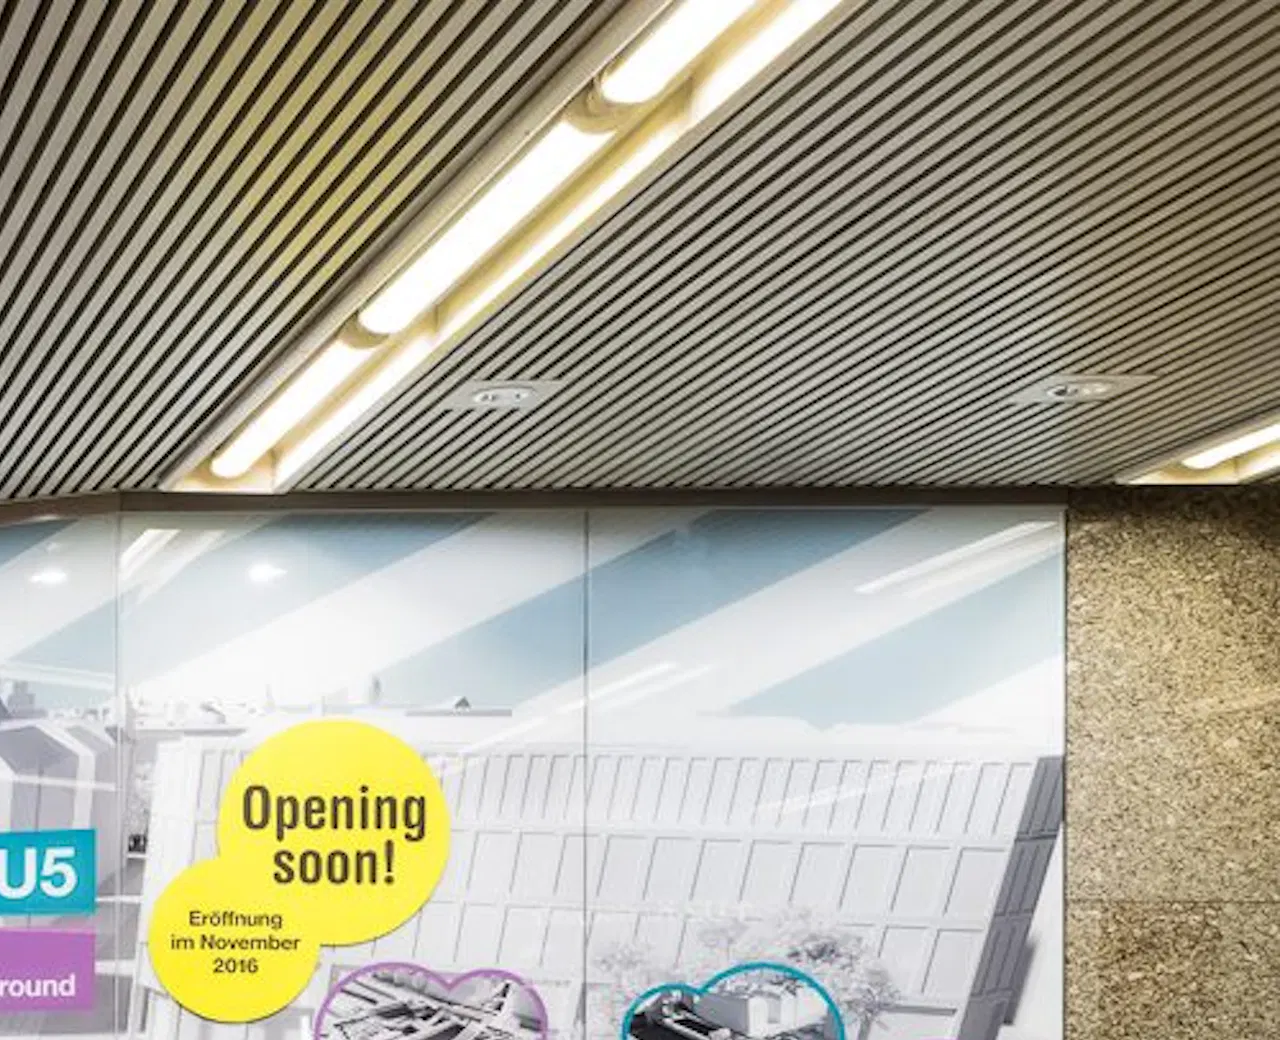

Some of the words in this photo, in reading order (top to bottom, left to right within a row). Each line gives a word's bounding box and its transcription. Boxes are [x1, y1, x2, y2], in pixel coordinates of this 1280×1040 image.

[242, 785, 426, 842] Opening
[273, 839, 395, 885] soon!
[188, 910, 283, 929] Eröffnung
[170, 934, 195, 950] im
[200, 934, 301, 951] November
[212, 957, 260, 974] 2016
